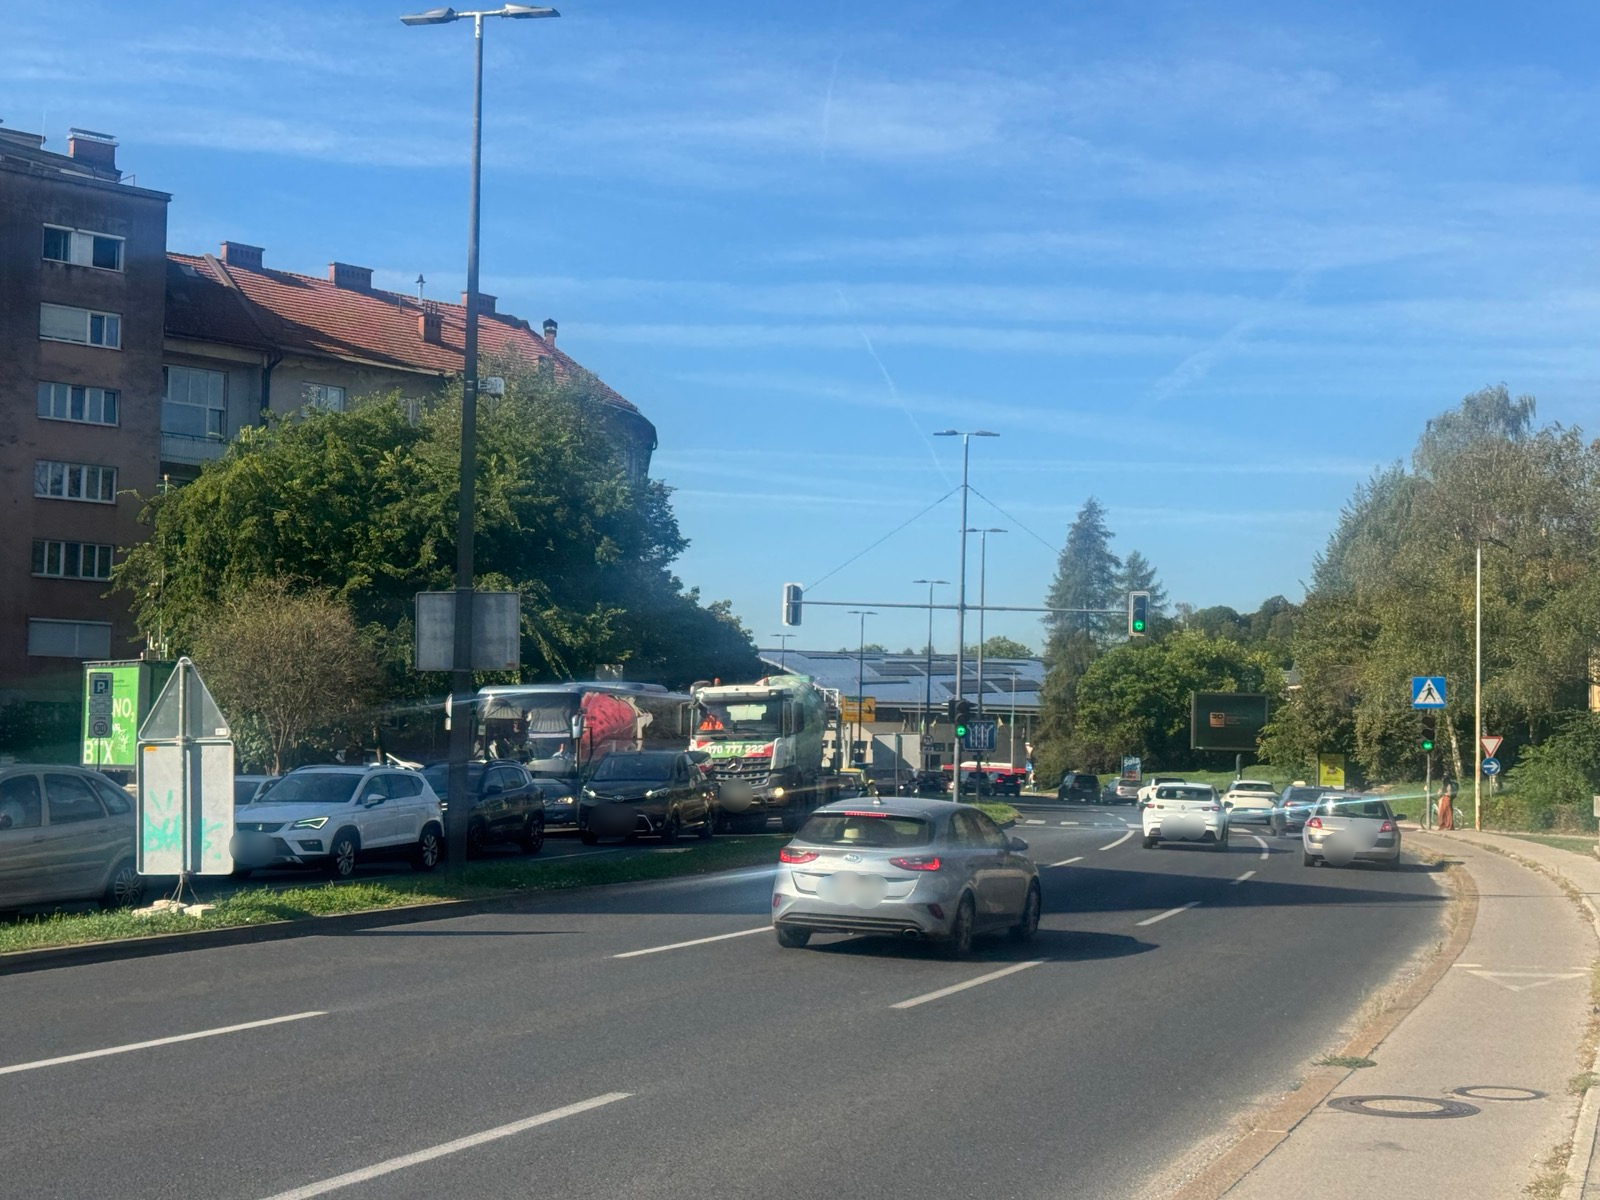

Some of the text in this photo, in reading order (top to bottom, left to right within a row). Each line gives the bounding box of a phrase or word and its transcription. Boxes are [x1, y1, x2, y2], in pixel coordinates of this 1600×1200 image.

[96, 724, 104, 733] 30
[726, 745, 743, 754] 777
[745, 745, 764, 754] 222
